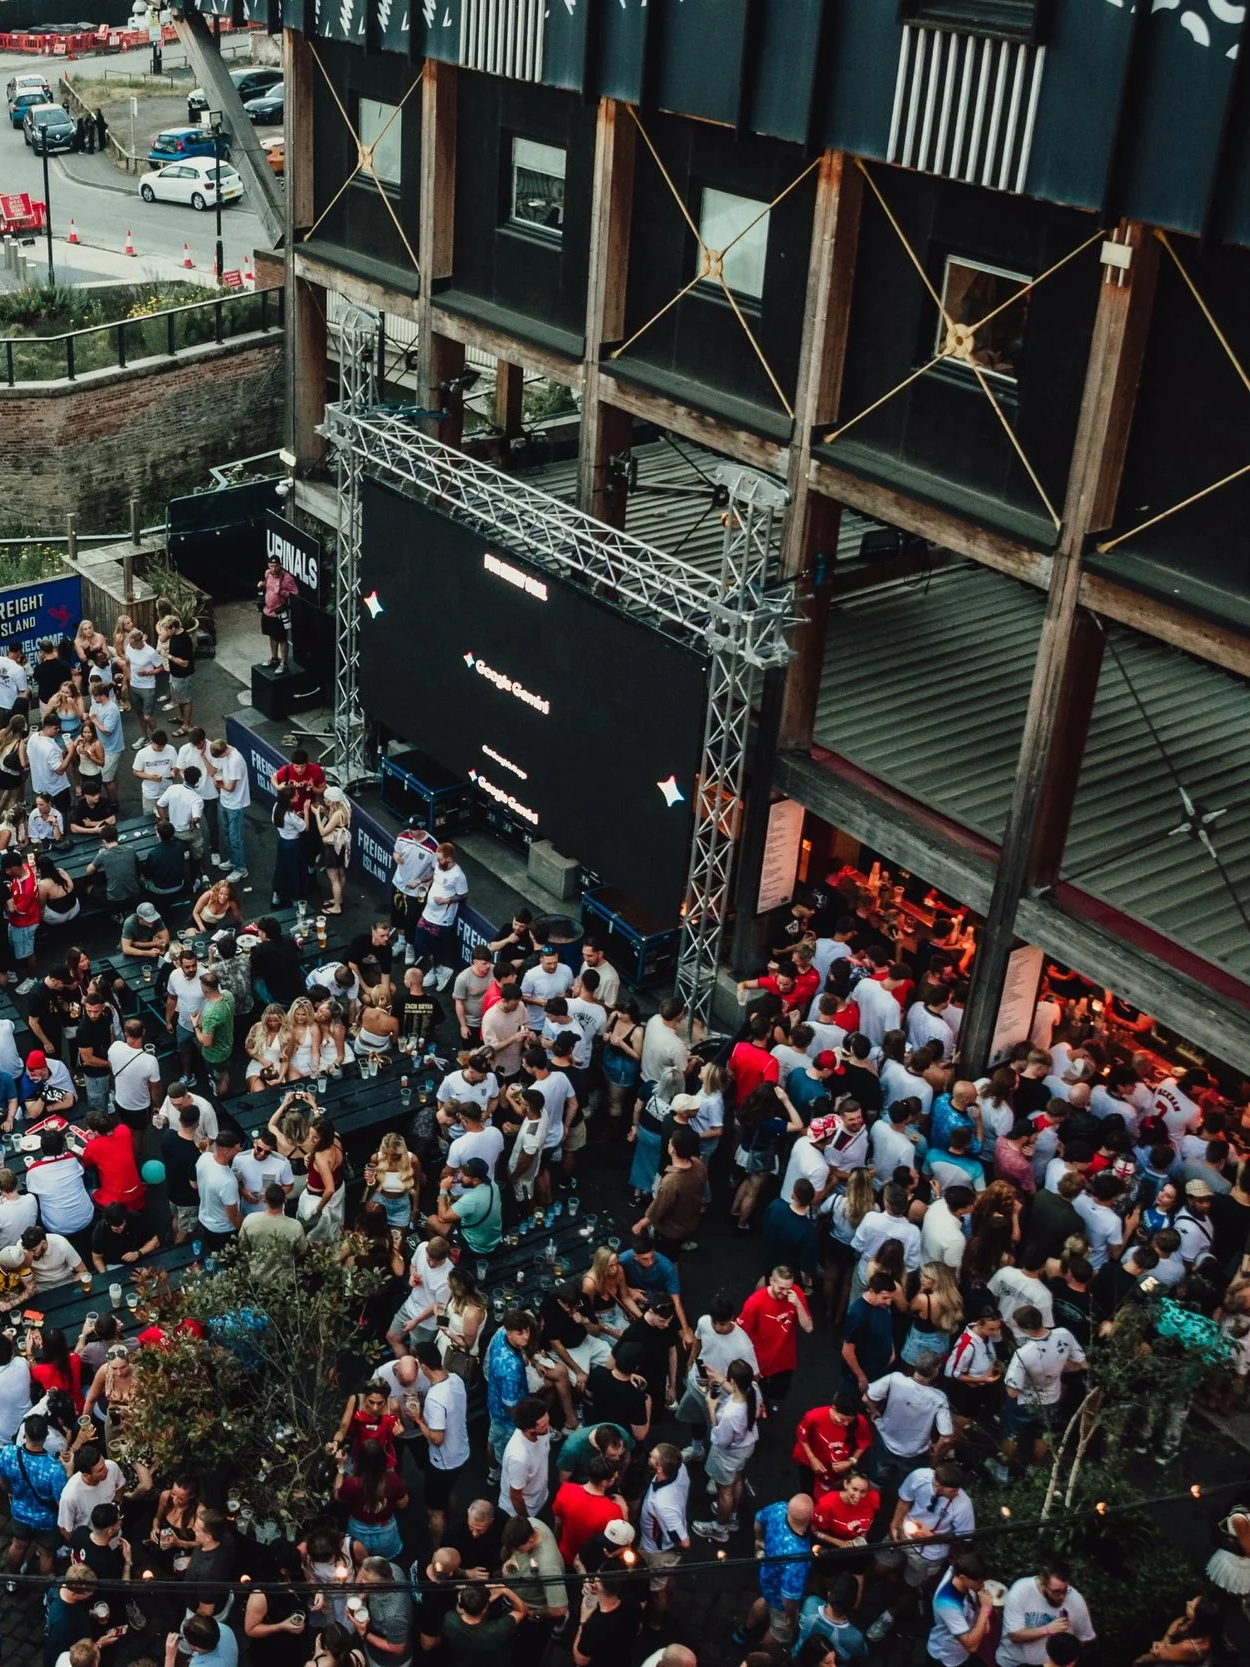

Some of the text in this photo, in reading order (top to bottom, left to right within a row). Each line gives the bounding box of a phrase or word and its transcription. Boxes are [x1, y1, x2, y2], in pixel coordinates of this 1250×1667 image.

[266, 528, 318, 590] URINALS
[475, 659, 550, 715] Google Gemini
[478, 775, 508, 804] Google
[357, 827, 393, 869] FREIGHT
[362, 853, 386, 883] ISLAND
